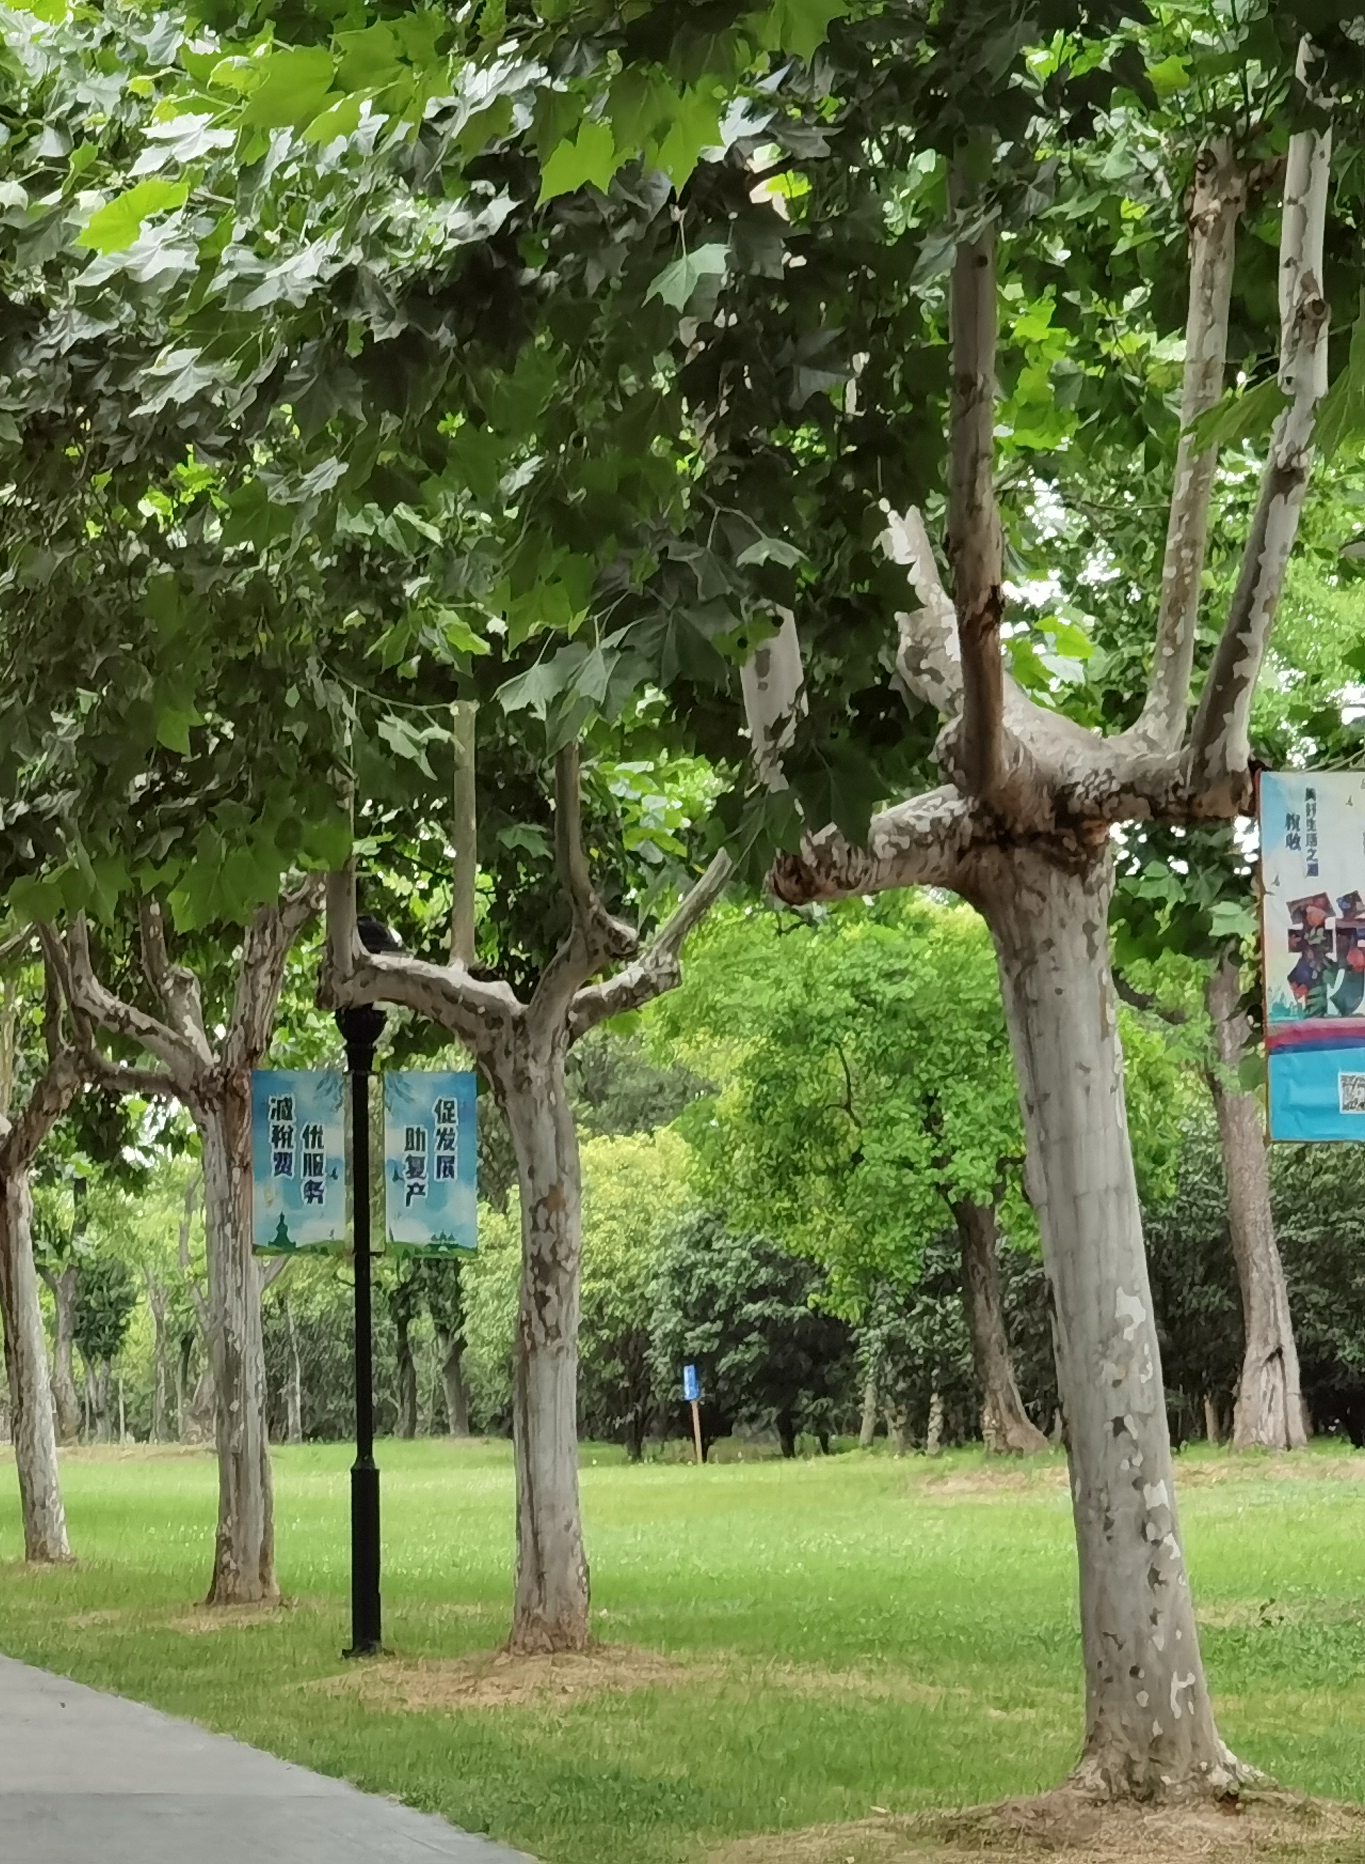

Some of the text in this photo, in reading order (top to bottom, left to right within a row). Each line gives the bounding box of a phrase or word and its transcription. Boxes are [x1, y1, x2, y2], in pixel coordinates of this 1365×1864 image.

[302, 1124, 325, 1204] 优服务
[435, 1099, 457, 1179] 促发展
